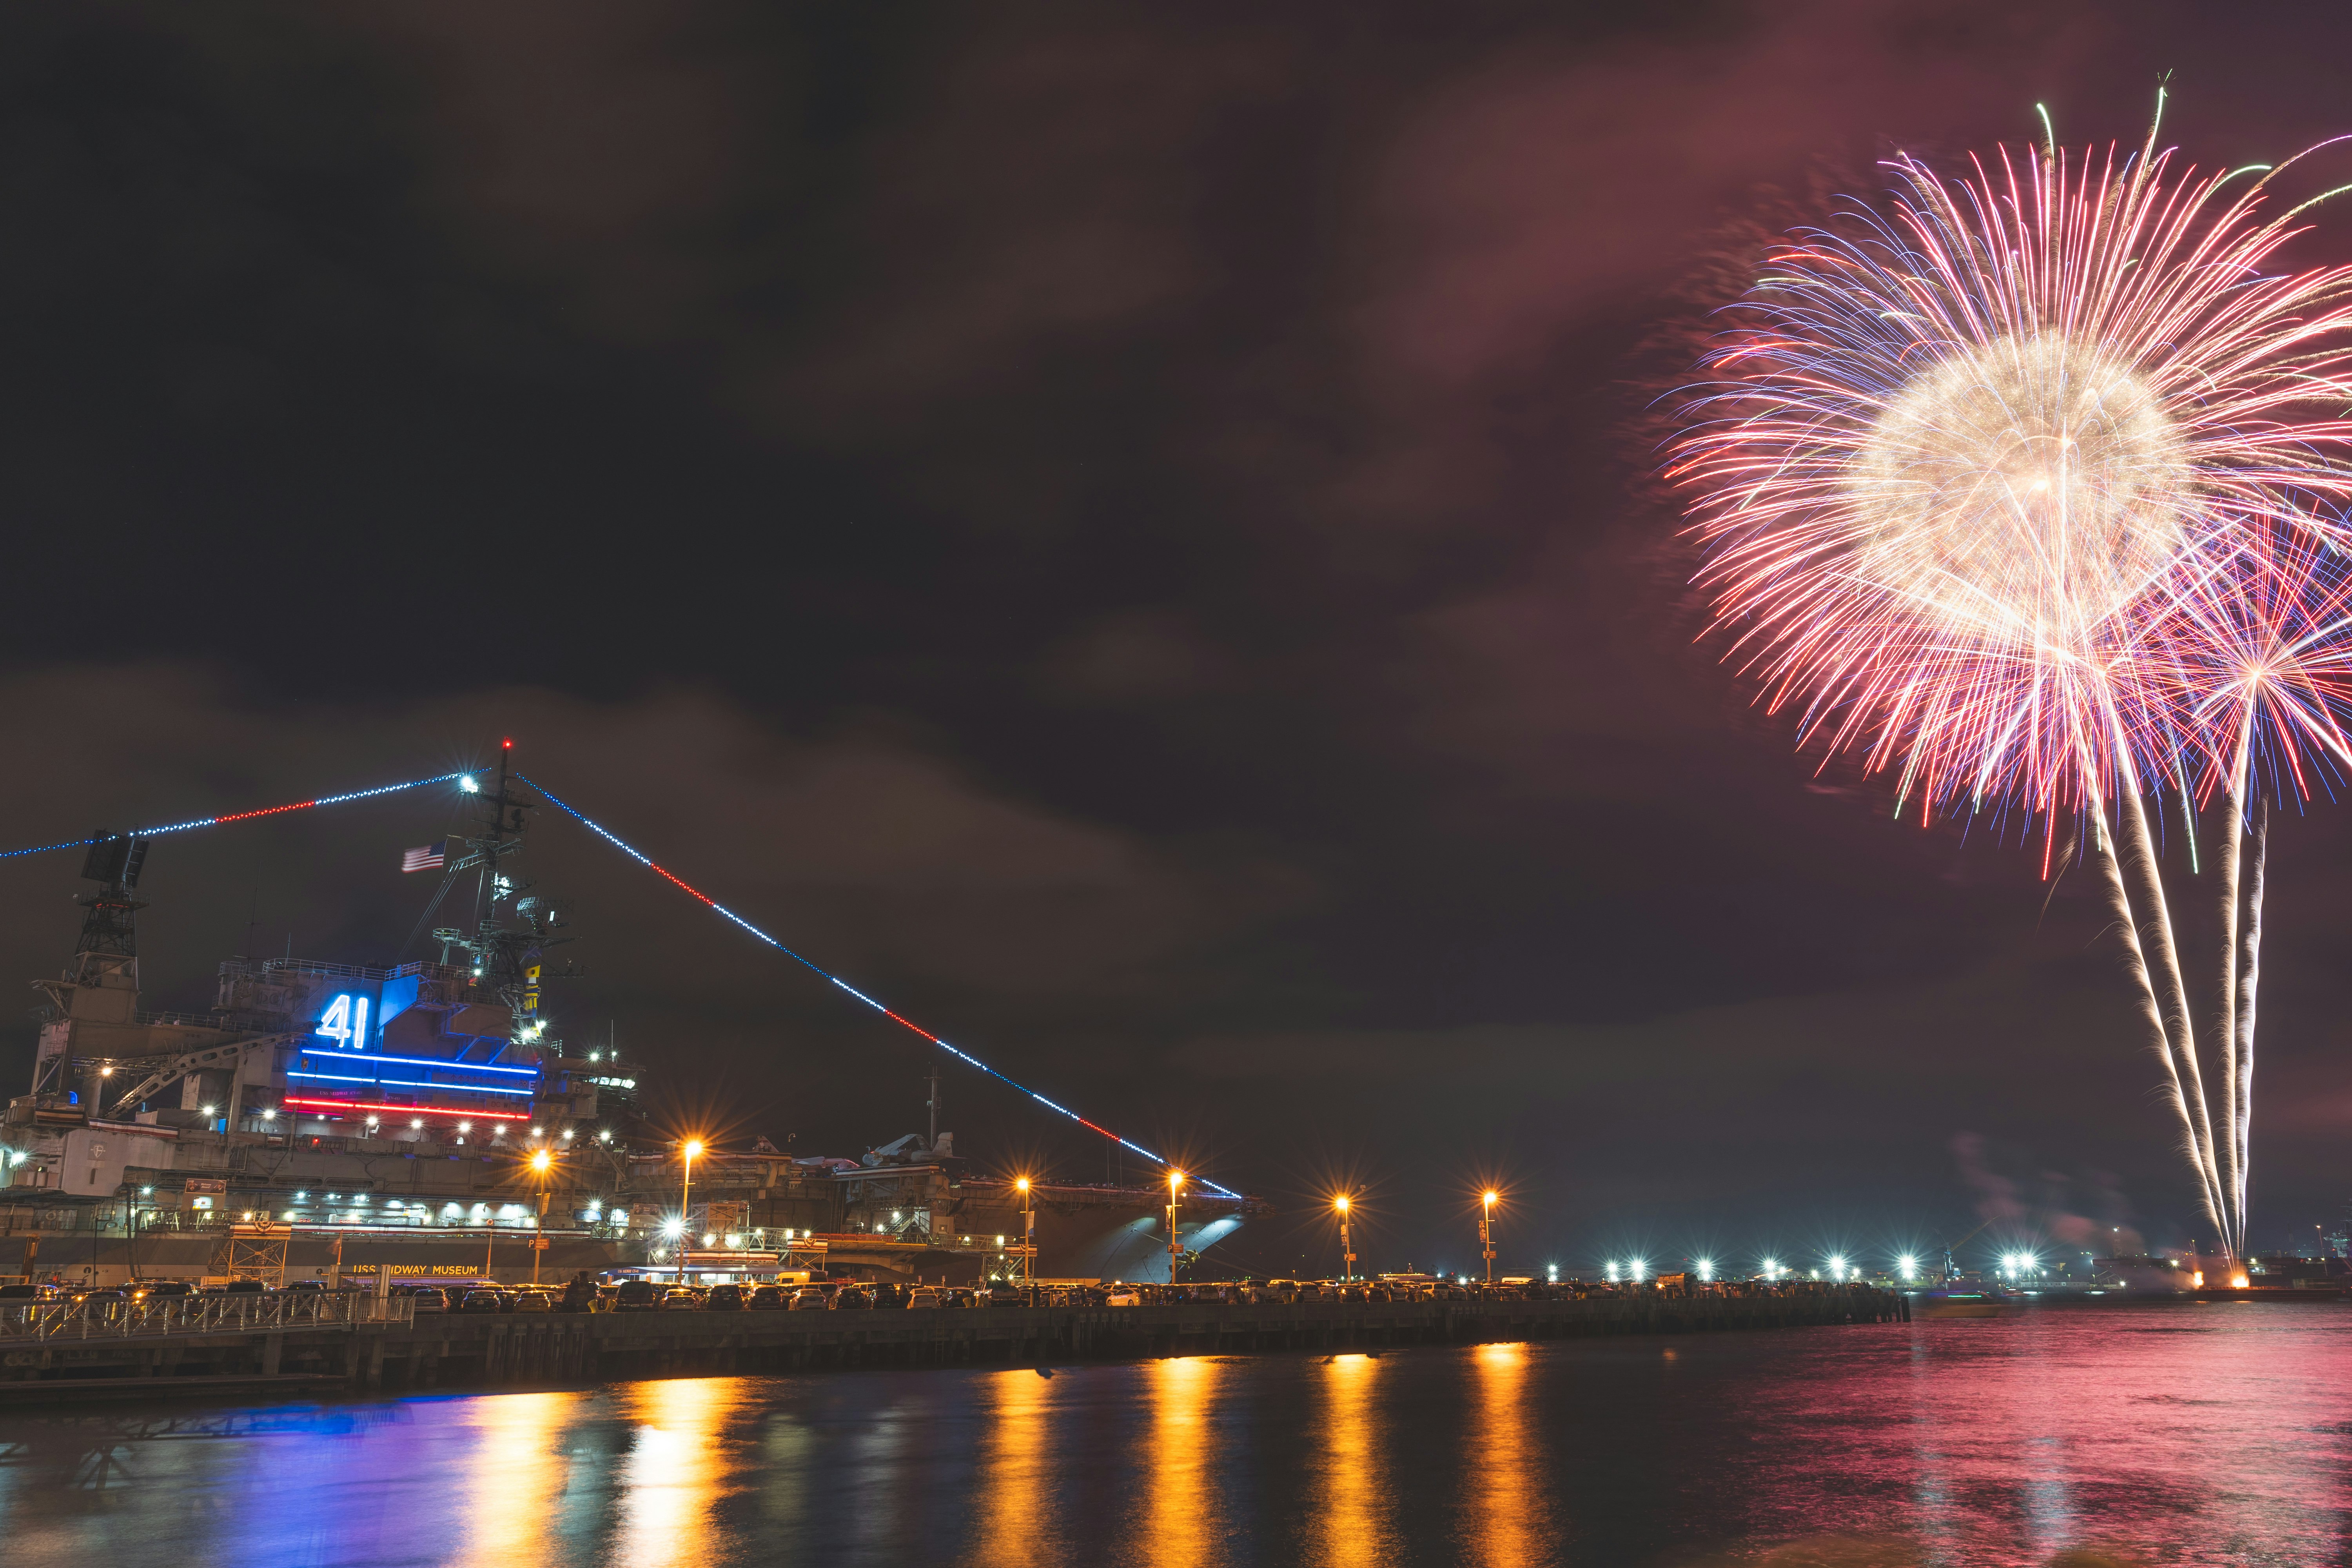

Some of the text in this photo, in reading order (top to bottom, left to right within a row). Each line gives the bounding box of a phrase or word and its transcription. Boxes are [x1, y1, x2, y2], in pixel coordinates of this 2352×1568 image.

[316, 995, 368, 1049] 41
[529, 1080, 536, 1090] E
[528, 1240, 534, 1248] P
[354, 1265, 478, 1275] USS IDWAY MUSEUM
